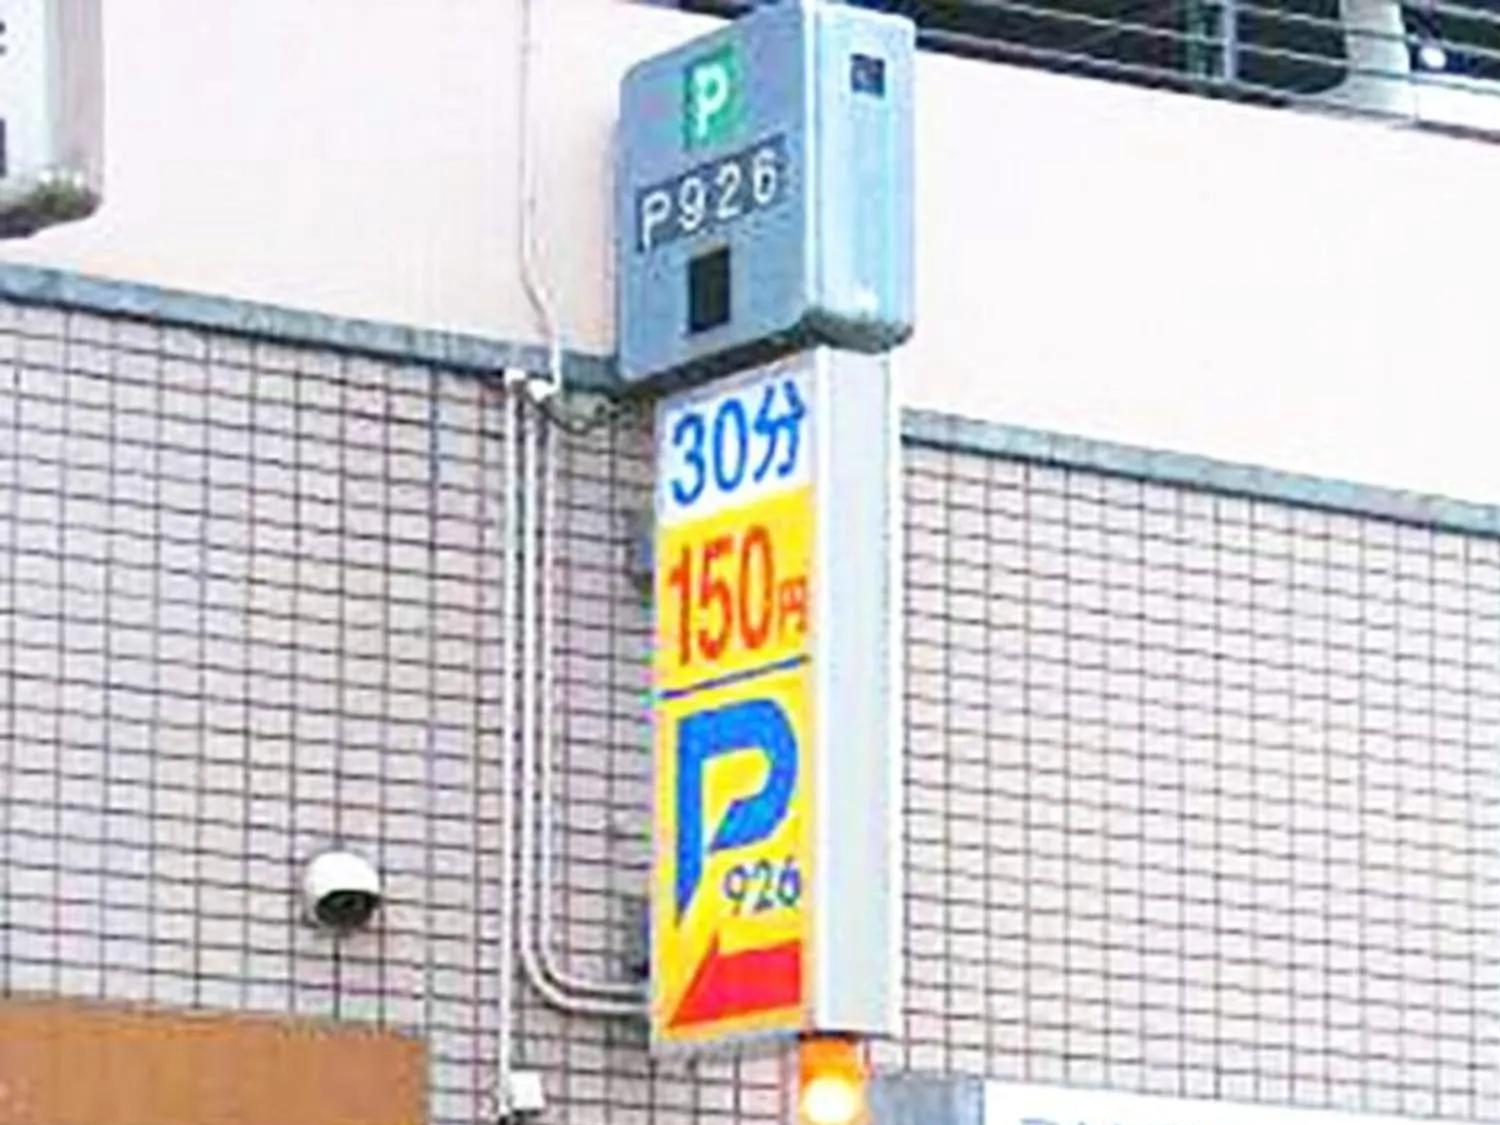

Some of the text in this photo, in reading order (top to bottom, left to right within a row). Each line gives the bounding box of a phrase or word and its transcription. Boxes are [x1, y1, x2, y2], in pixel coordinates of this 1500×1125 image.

[692, 62, 729, 139] P
[640, 147, 778, 251] P926
[669, 378, 806, 510] 30分
[667, 523, 809, 668] 150円
[676, 697, 799, 929] P
[722, 852, 799, 916] 926
